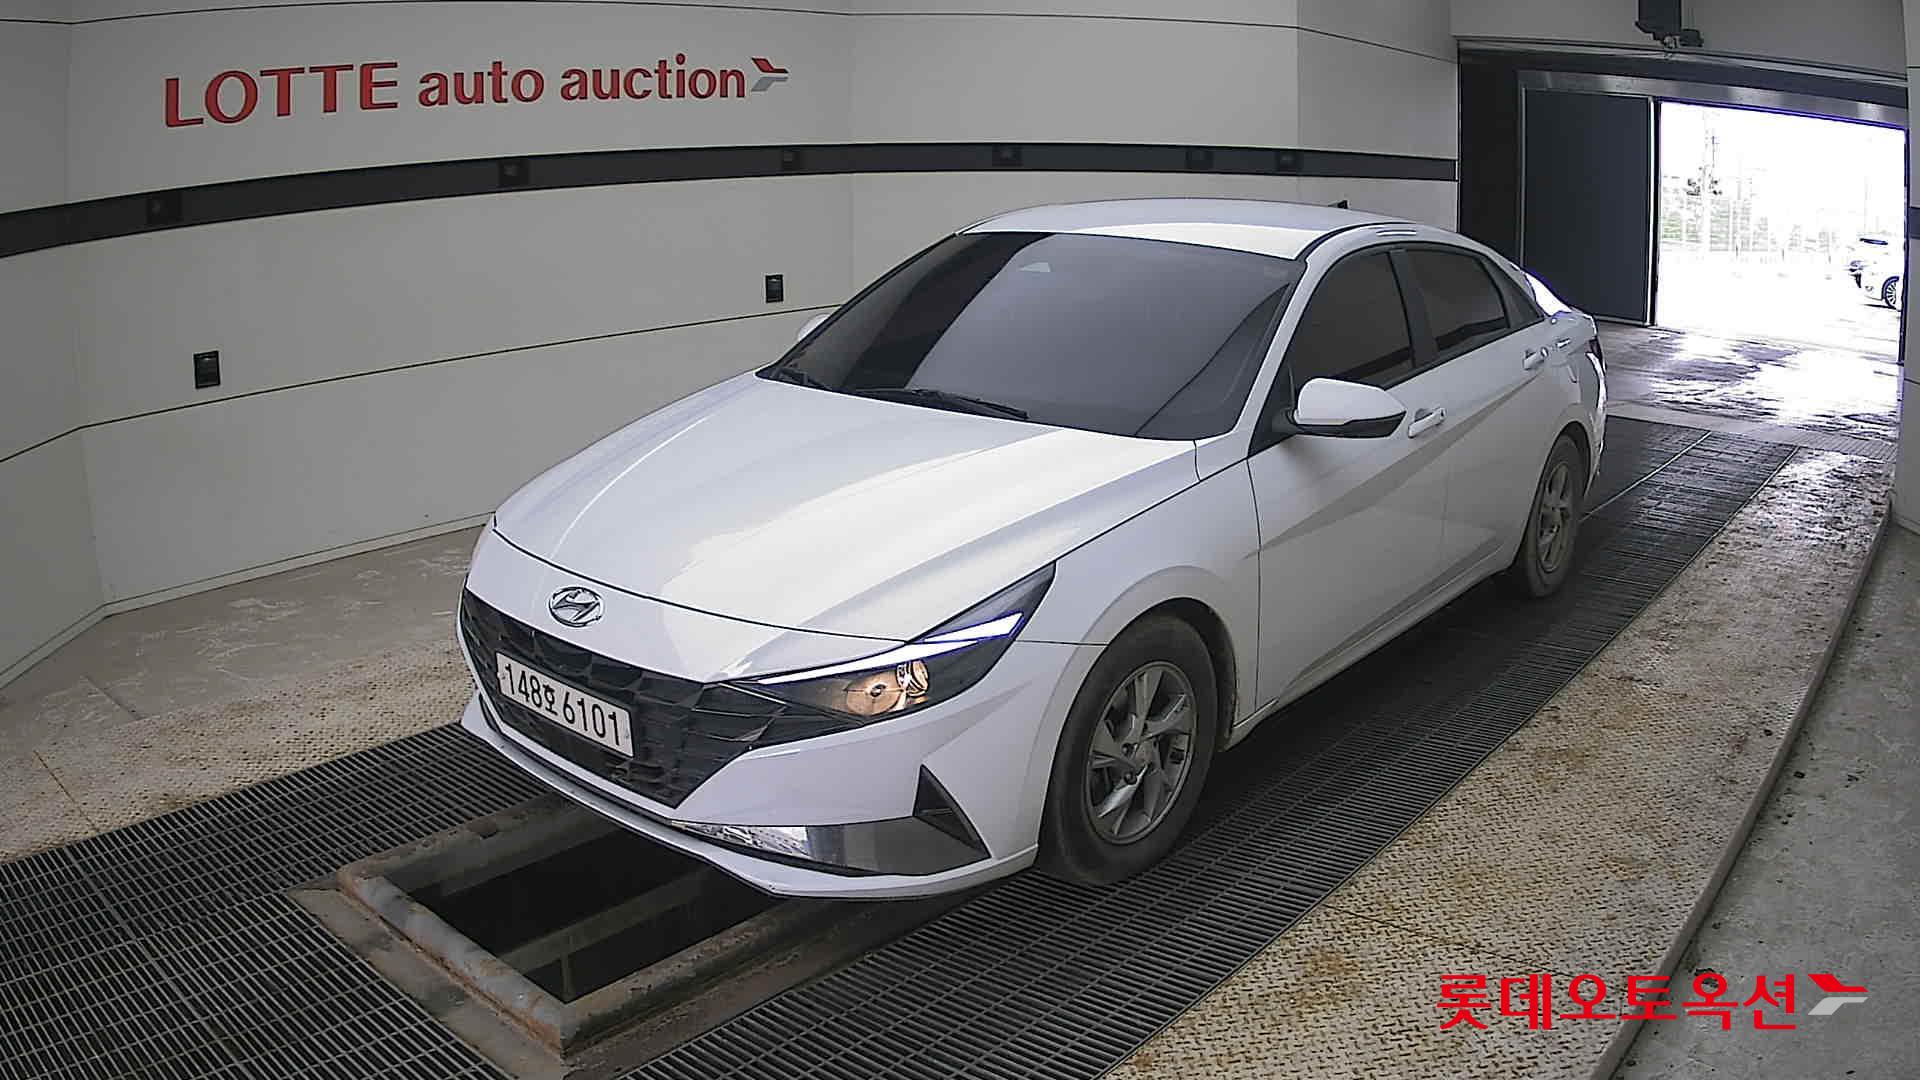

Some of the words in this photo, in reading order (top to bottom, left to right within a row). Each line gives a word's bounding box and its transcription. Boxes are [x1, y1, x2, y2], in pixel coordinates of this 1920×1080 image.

[164, 61, 399, 128] LOTTE
[418, 60, 545, 107] auto
[560, 53, 746, 100] auction
